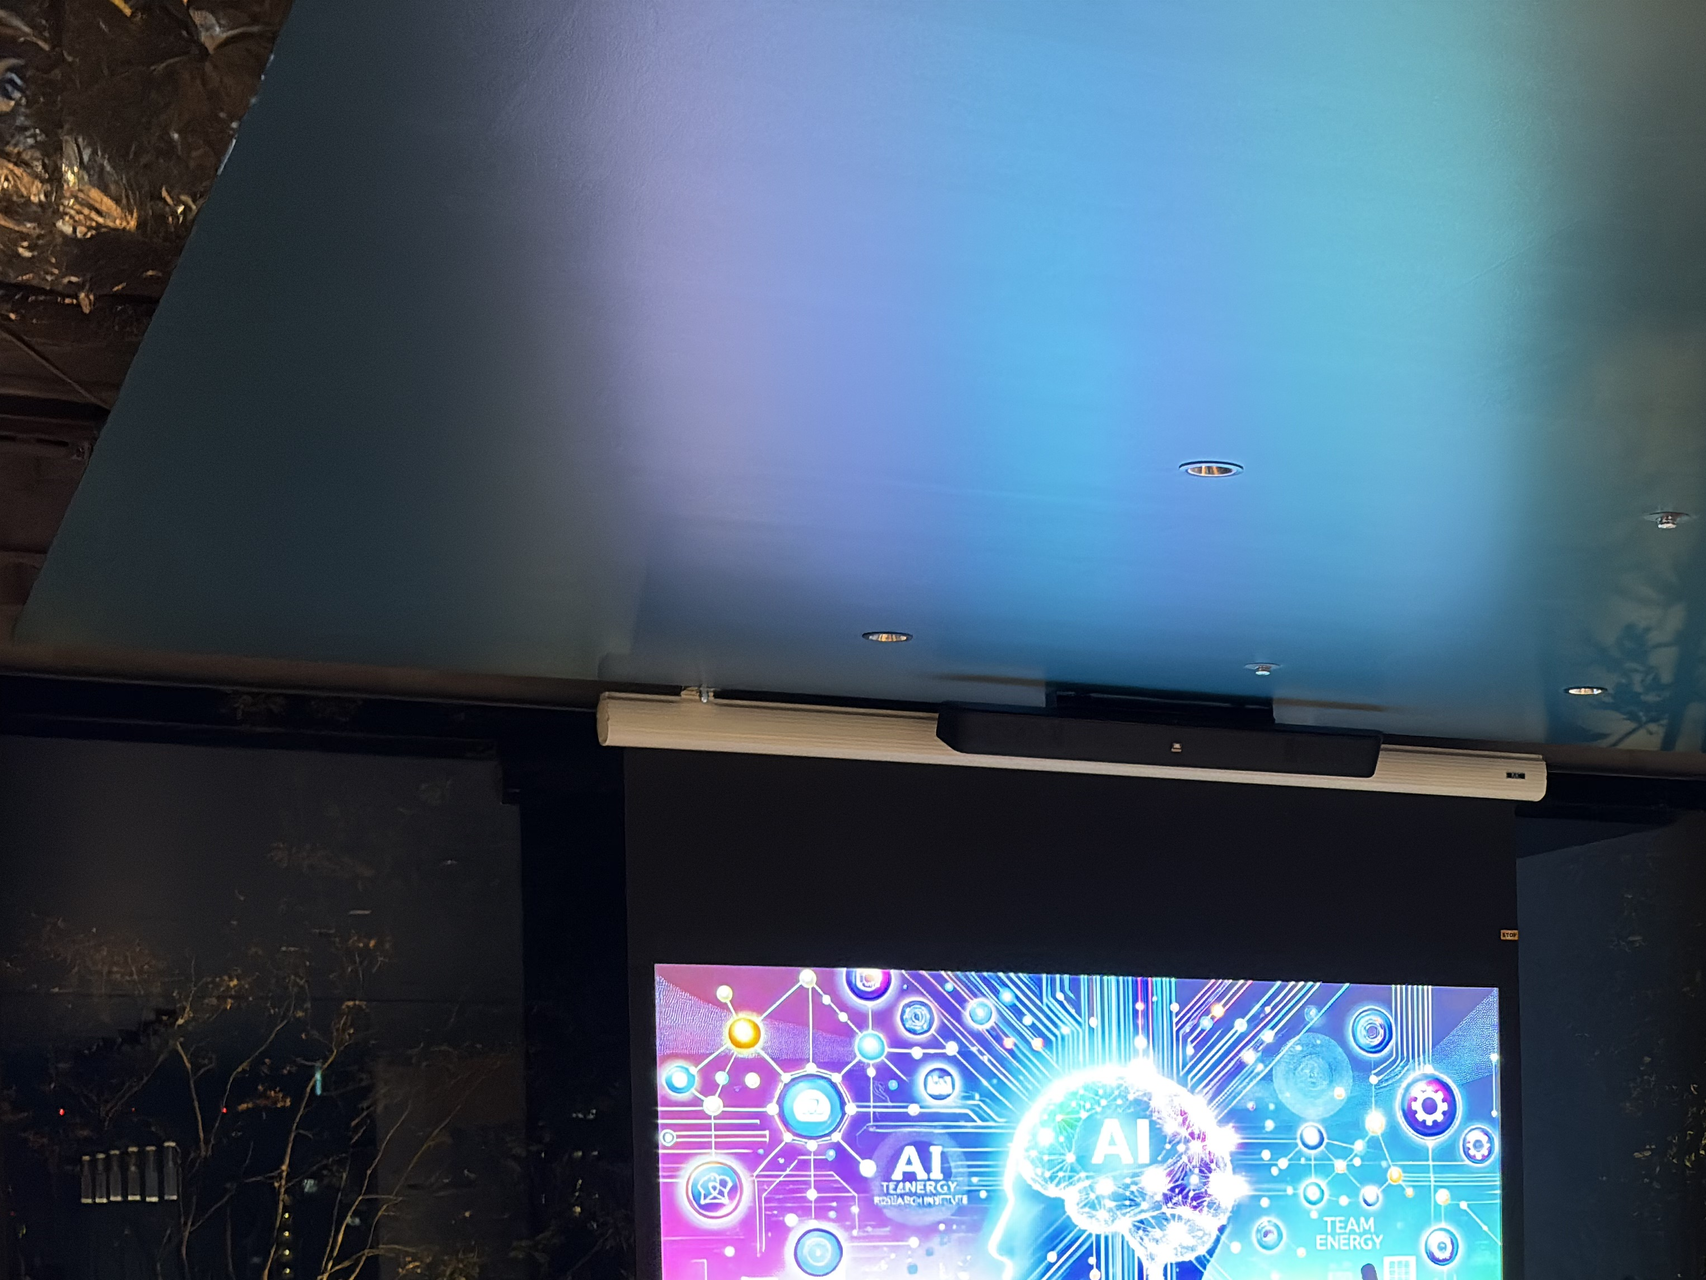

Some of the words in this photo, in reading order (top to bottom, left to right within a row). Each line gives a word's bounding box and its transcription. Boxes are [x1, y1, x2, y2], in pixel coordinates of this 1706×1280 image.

[1091, 1118, 1150, 1164] AI
[891, 1145, 944, 1180] AI
[1323, 1216, 1375, 1233] TEAM
[1316, 1234, 1384, 1250] ENERGY
